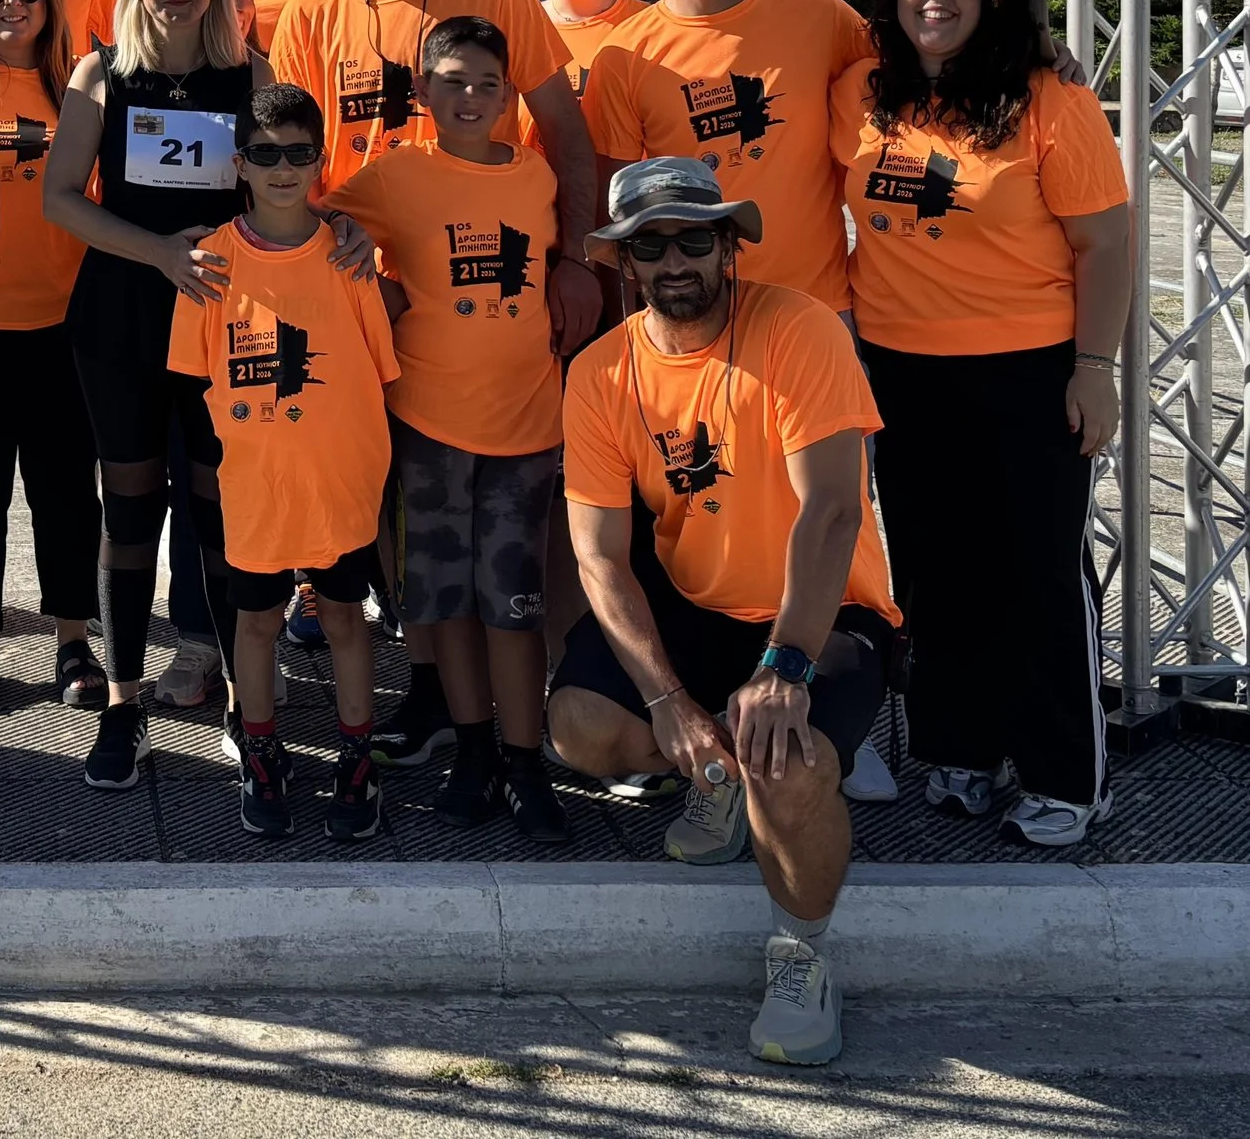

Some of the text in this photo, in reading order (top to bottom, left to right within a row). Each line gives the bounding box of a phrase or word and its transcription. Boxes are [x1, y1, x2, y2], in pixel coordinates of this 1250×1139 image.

[346, 70, 382, 81] ΔΡΟΜΟΣ
[693, 85, 732, 101] ΔΡΟΜΟΣ
[347, 100, 365, 116] 21
[695, 94, 734, 110] ΜΝΗΜΗΣ
[700, 117, 717, 135] 21
[159, 139, 203, 167] 21
[886, 154, 925, 164] ΔΡΟΜΟΣ
[883, 164, 924, 173] ΜΝΗΜΗΣ
[874, 179, 897, 195] 21
[457, 234, 499, 243] ΔΡΟΜΟΣ
[458, 243, 499, 253] ΜΝΗΜΗΣ
[460, 263, 478, 279] 21
[236, 332, 275, 343] ΔΡΟΜΟΣ
[237, 342, 275, 354] ΜΝΗΜΗΣ
[236, 363, 254, 380] 21
